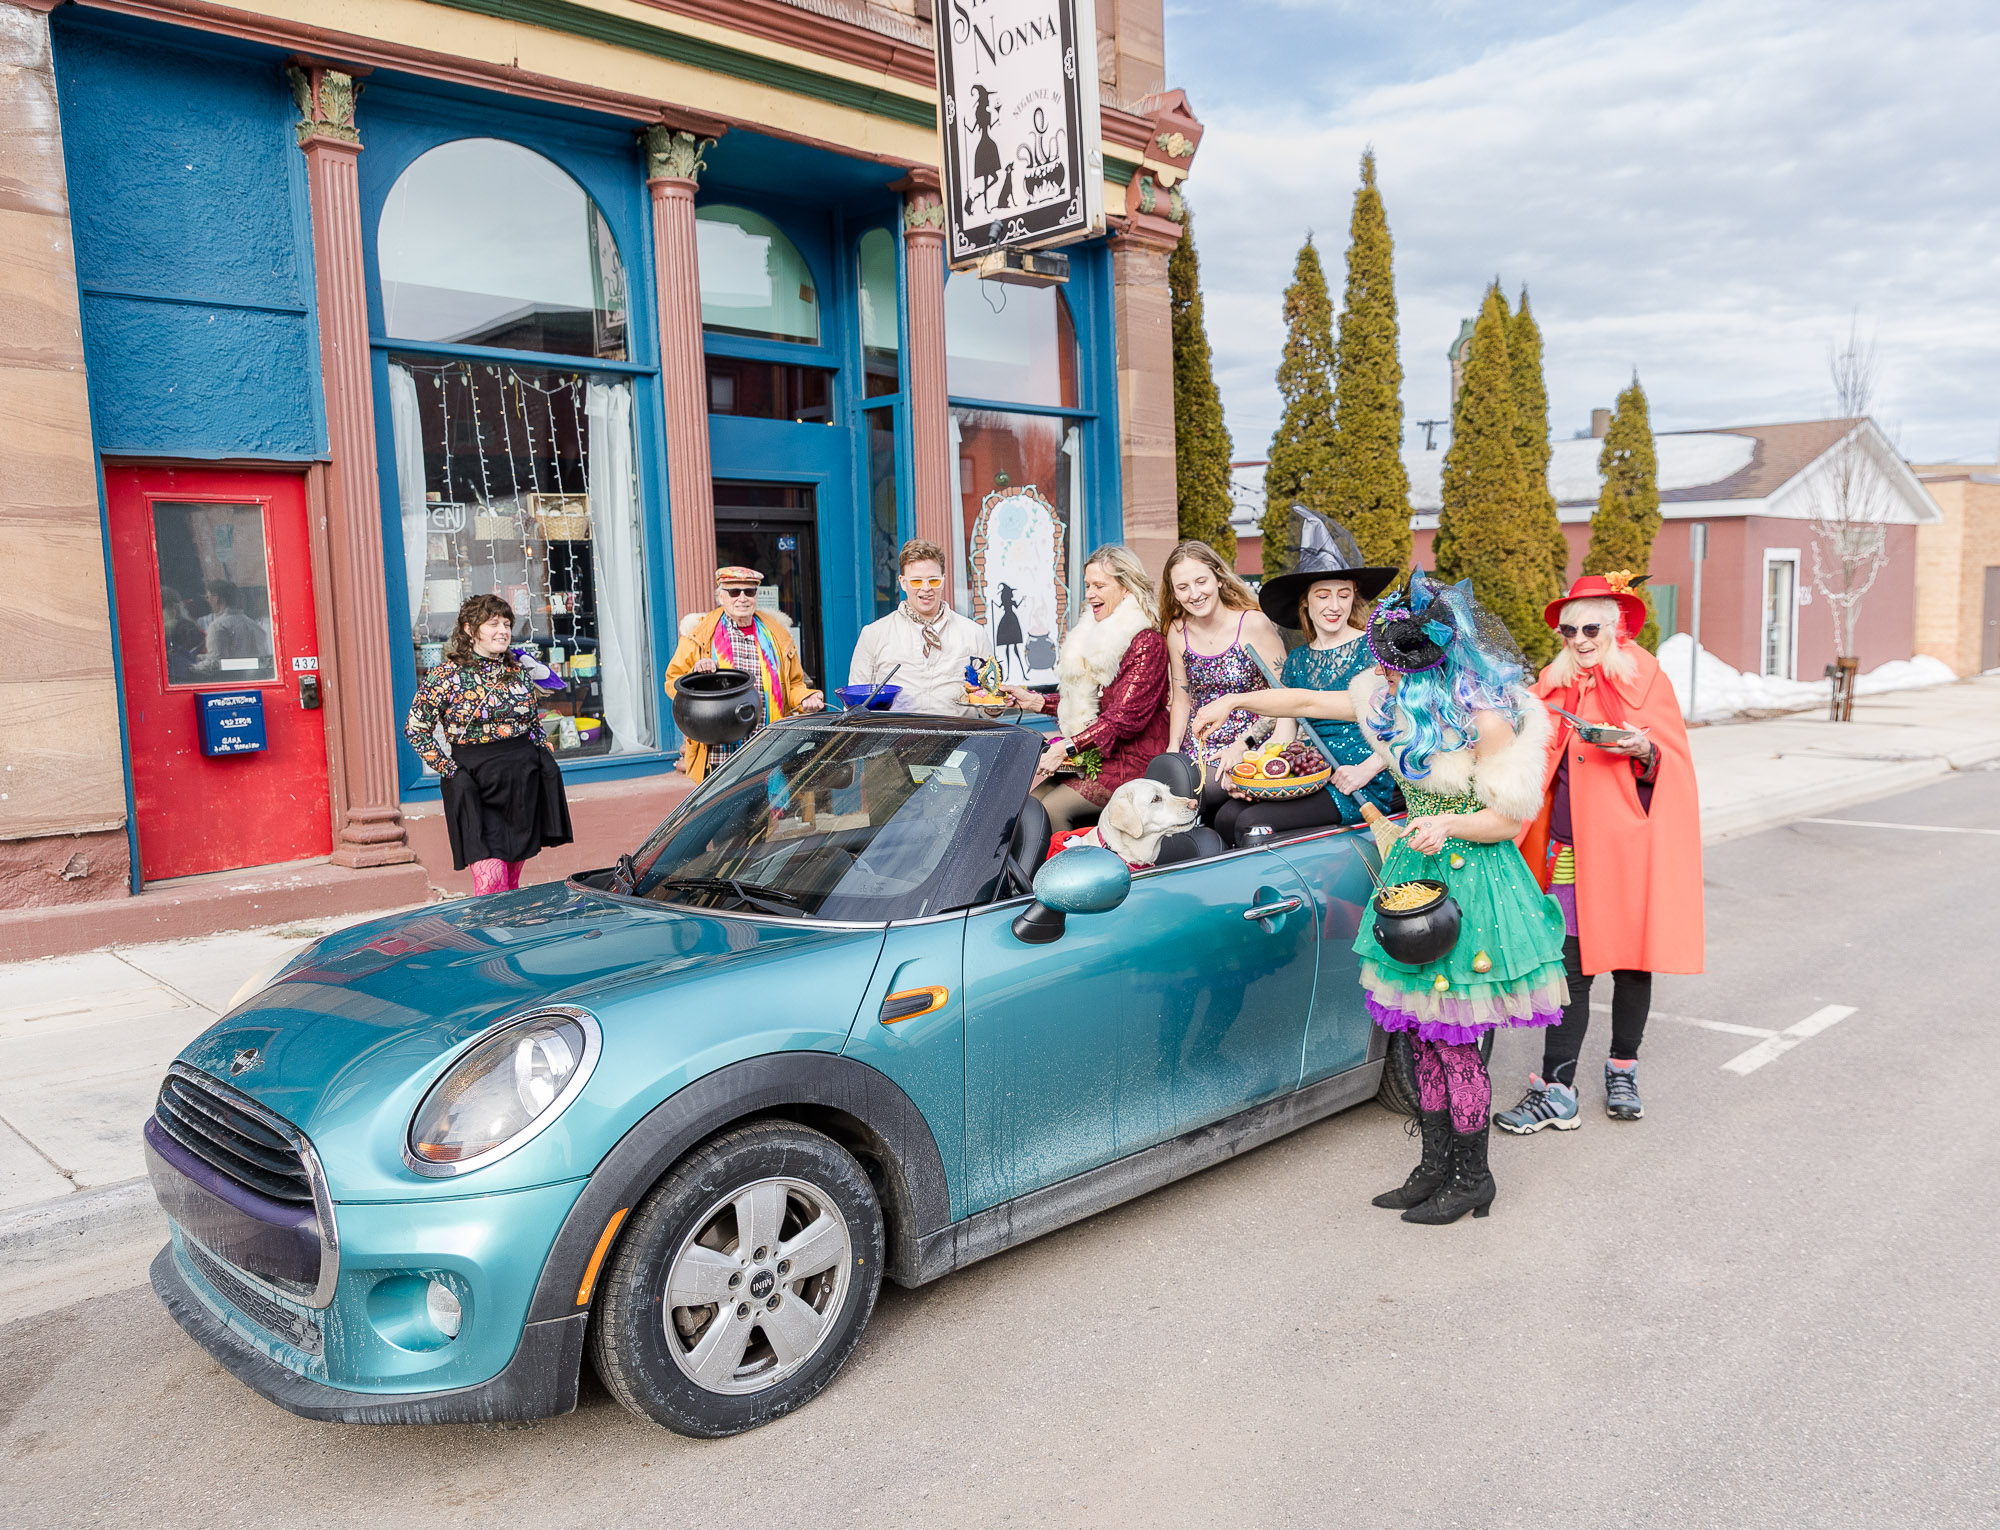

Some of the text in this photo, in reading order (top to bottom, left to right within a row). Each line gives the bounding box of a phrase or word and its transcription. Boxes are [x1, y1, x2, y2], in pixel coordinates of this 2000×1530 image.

[973, 14, 1057, 75] NONNA
[295, 658, 316, 669] 432
[753, 1278, 773, 1292] MINI
